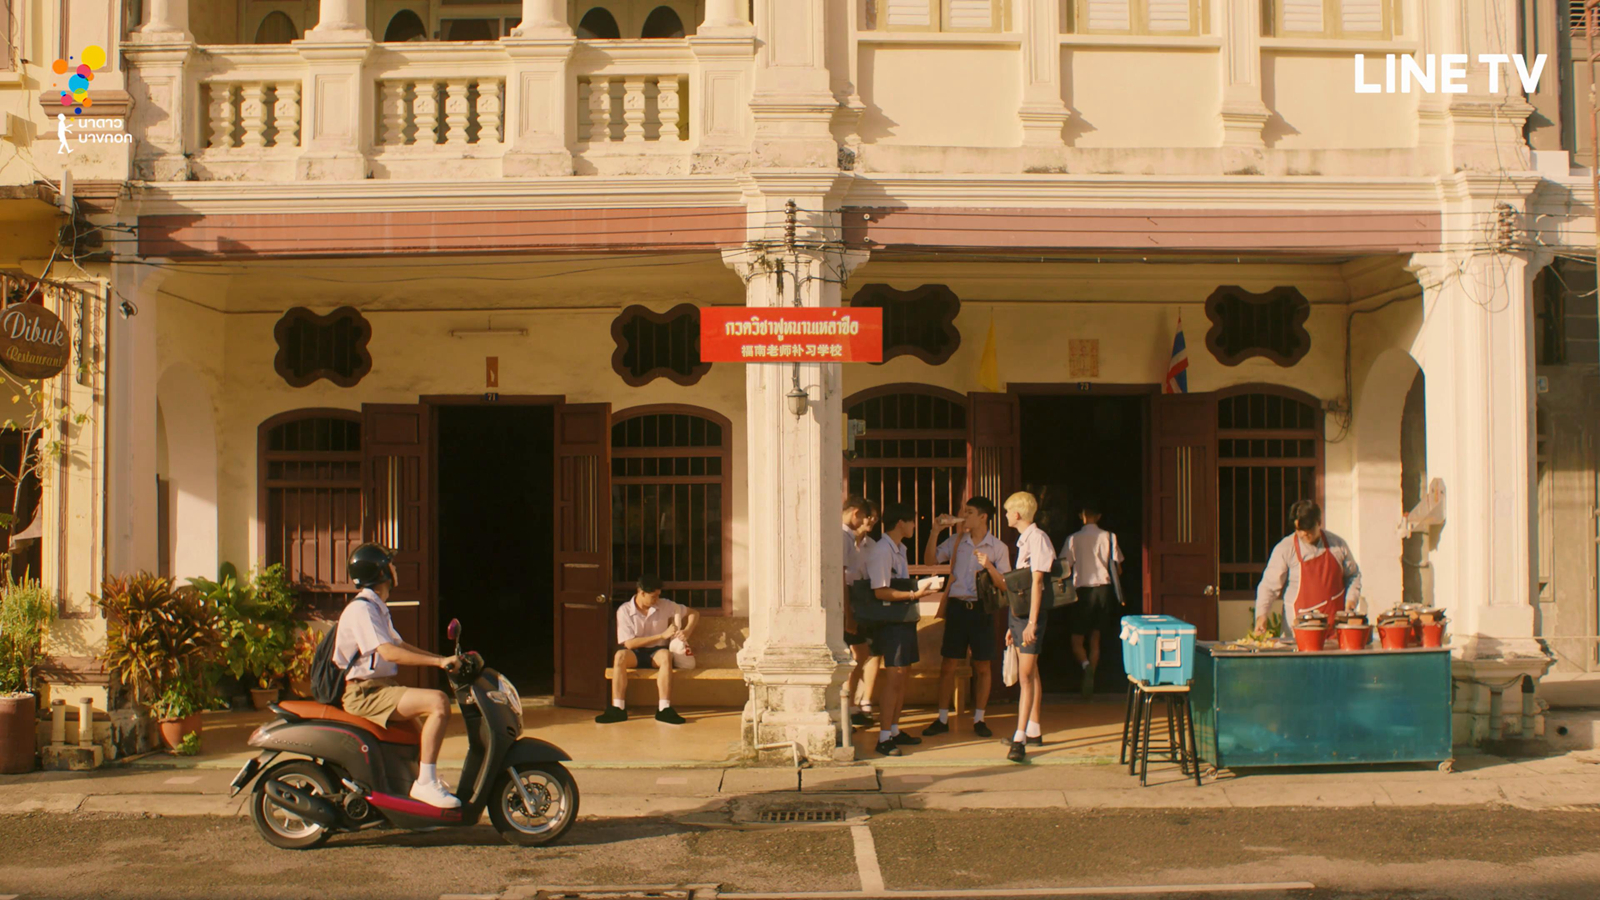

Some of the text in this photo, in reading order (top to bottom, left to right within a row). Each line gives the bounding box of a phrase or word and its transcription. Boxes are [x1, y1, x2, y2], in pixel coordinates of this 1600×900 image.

[3, 310, 65, 346] Dibuk
[6, 345, 63, 367] Restaurant
[741, 344, 843, 358] 福南老师补习学校
